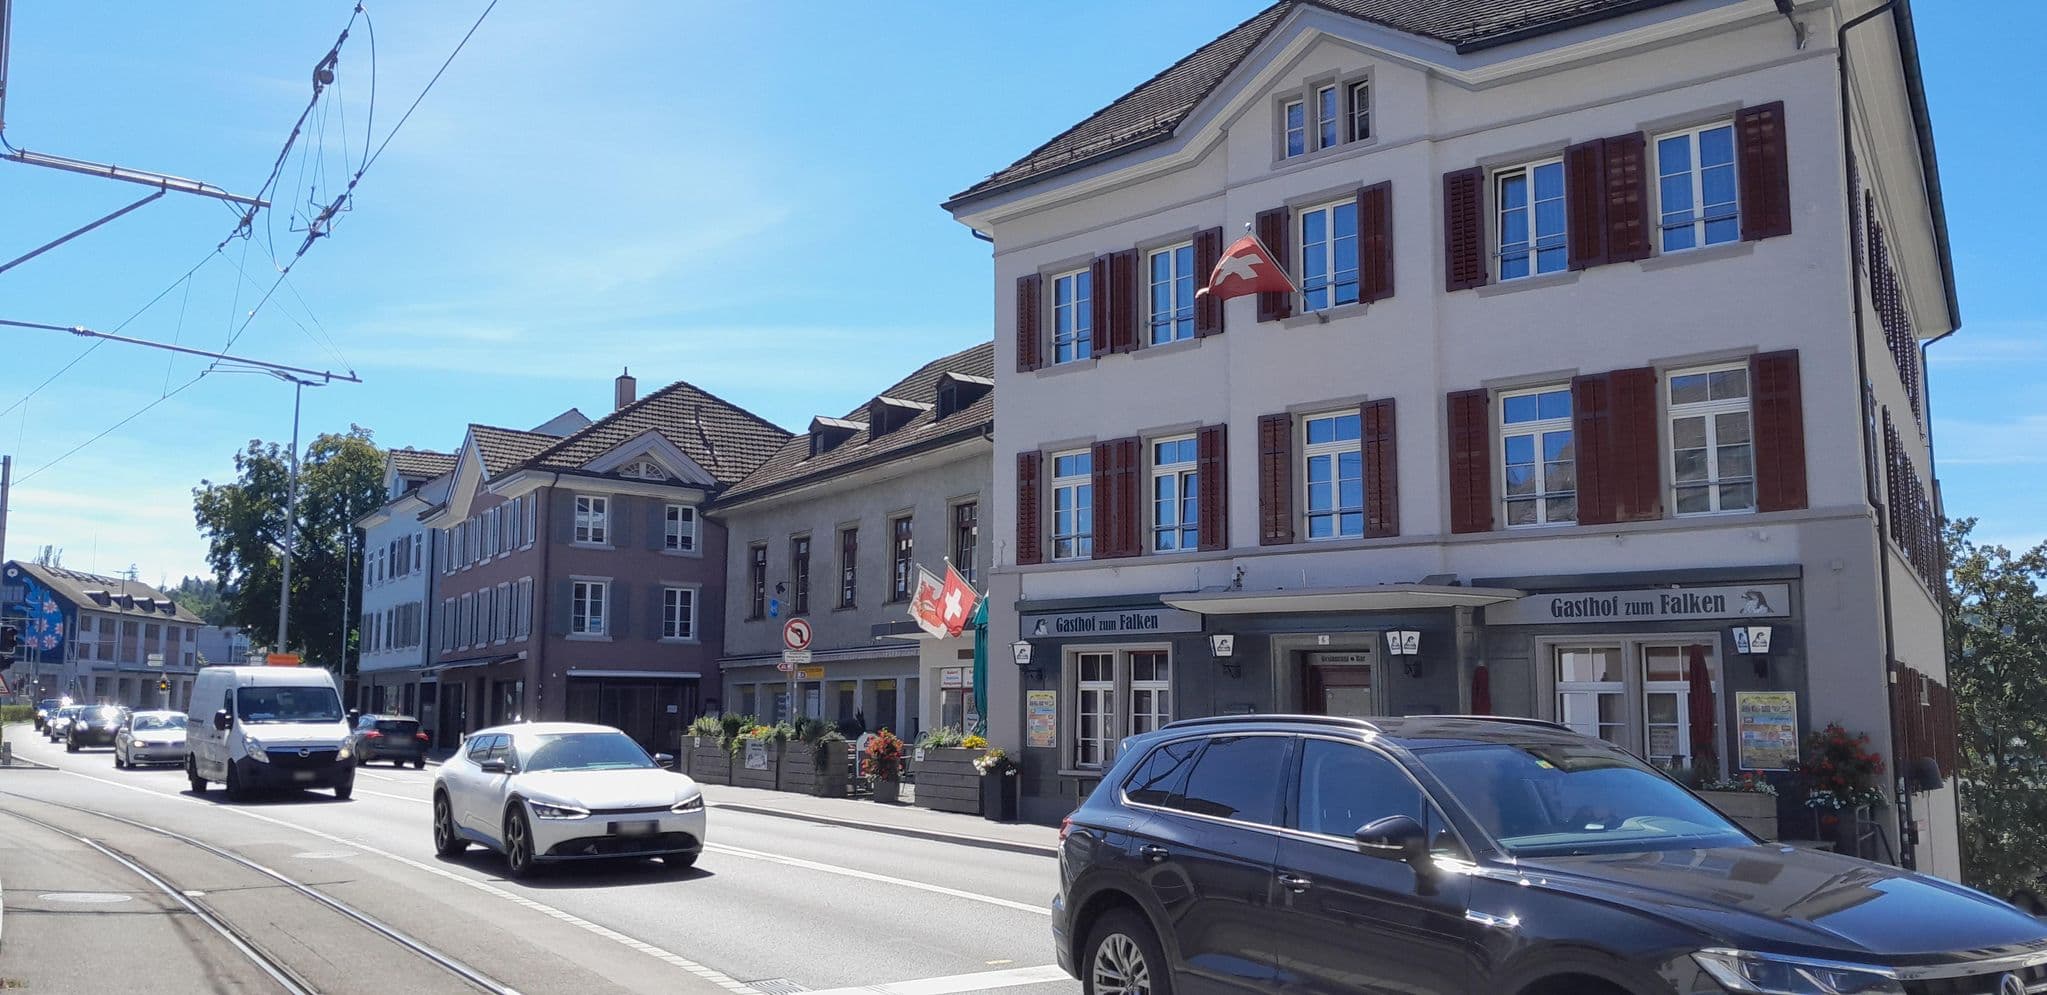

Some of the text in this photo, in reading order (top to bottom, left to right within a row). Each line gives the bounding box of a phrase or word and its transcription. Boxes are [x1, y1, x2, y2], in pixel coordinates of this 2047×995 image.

[1551, 592, 1726, 618] Gasthof zum Falken
[1056, 614, 1158, 632] Gasthof zum Falken
